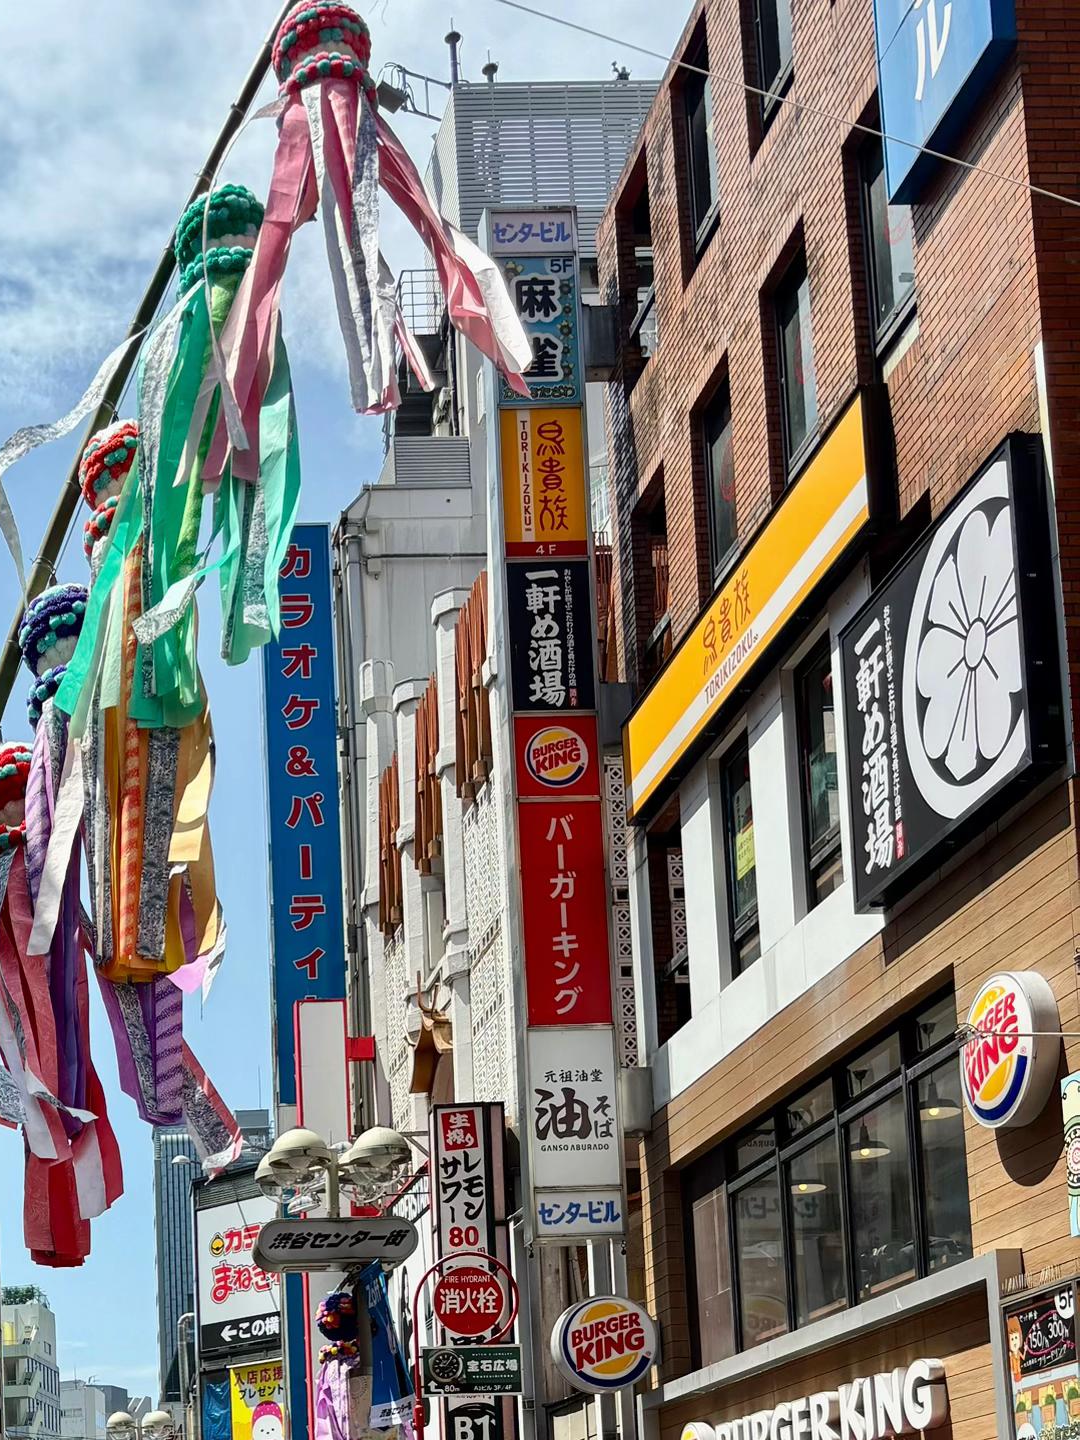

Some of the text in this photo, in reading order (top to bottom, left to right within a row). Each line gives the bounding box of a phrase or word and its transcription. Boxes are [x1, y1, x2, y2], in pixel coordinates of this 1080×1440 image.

[493, 221, 571, 244] センタービル
[550, 258, 573, 274] 5F
[520, 420, 532, 526] TORIKIZOKU
[537, 419, 569, 532] 鳥貴族
[535, 544, 557, 555] 4F
[525, 568, 567, 708] 一軒め酒場
[703, 630, 754, 706] TORIKIZOKU
[531, 736, 580, 761] BURGER
[854, 617, 895, 876] 一軒め酒場
[534, 747, 582, 775] KING
[545, 813, 584, 1016] バーガーキング
[965, 1014, 1019, 1106] KING
[543, 1068, 604, 1084] 元祖油堂
[540, 1143, 610, 1152] GANSO ABURADO
[440, 1155, 464, 1224] サワー
[462, 1150, 486, 1221] レモン
[538, 1199, 621, 1226] センタービル
[268, 1229, 409, 1250] 渋谷センター街
[448, 1225, 480, 1248] 80
[444, 1274, 491, 1284] FIRE HYDRANT
[439, 1286, 499, 1315] 消火栓
[238, 1315, 281, 1339] この横
[571, 1312, 641, 1348] BURGER
[574, 1327, 646, 1373] KING
[466, 1358, 519, 1373] 宝石広場
[239, 1383, 284, 1401] プレゼント
[444, 1384, 460, 1392] 80m
